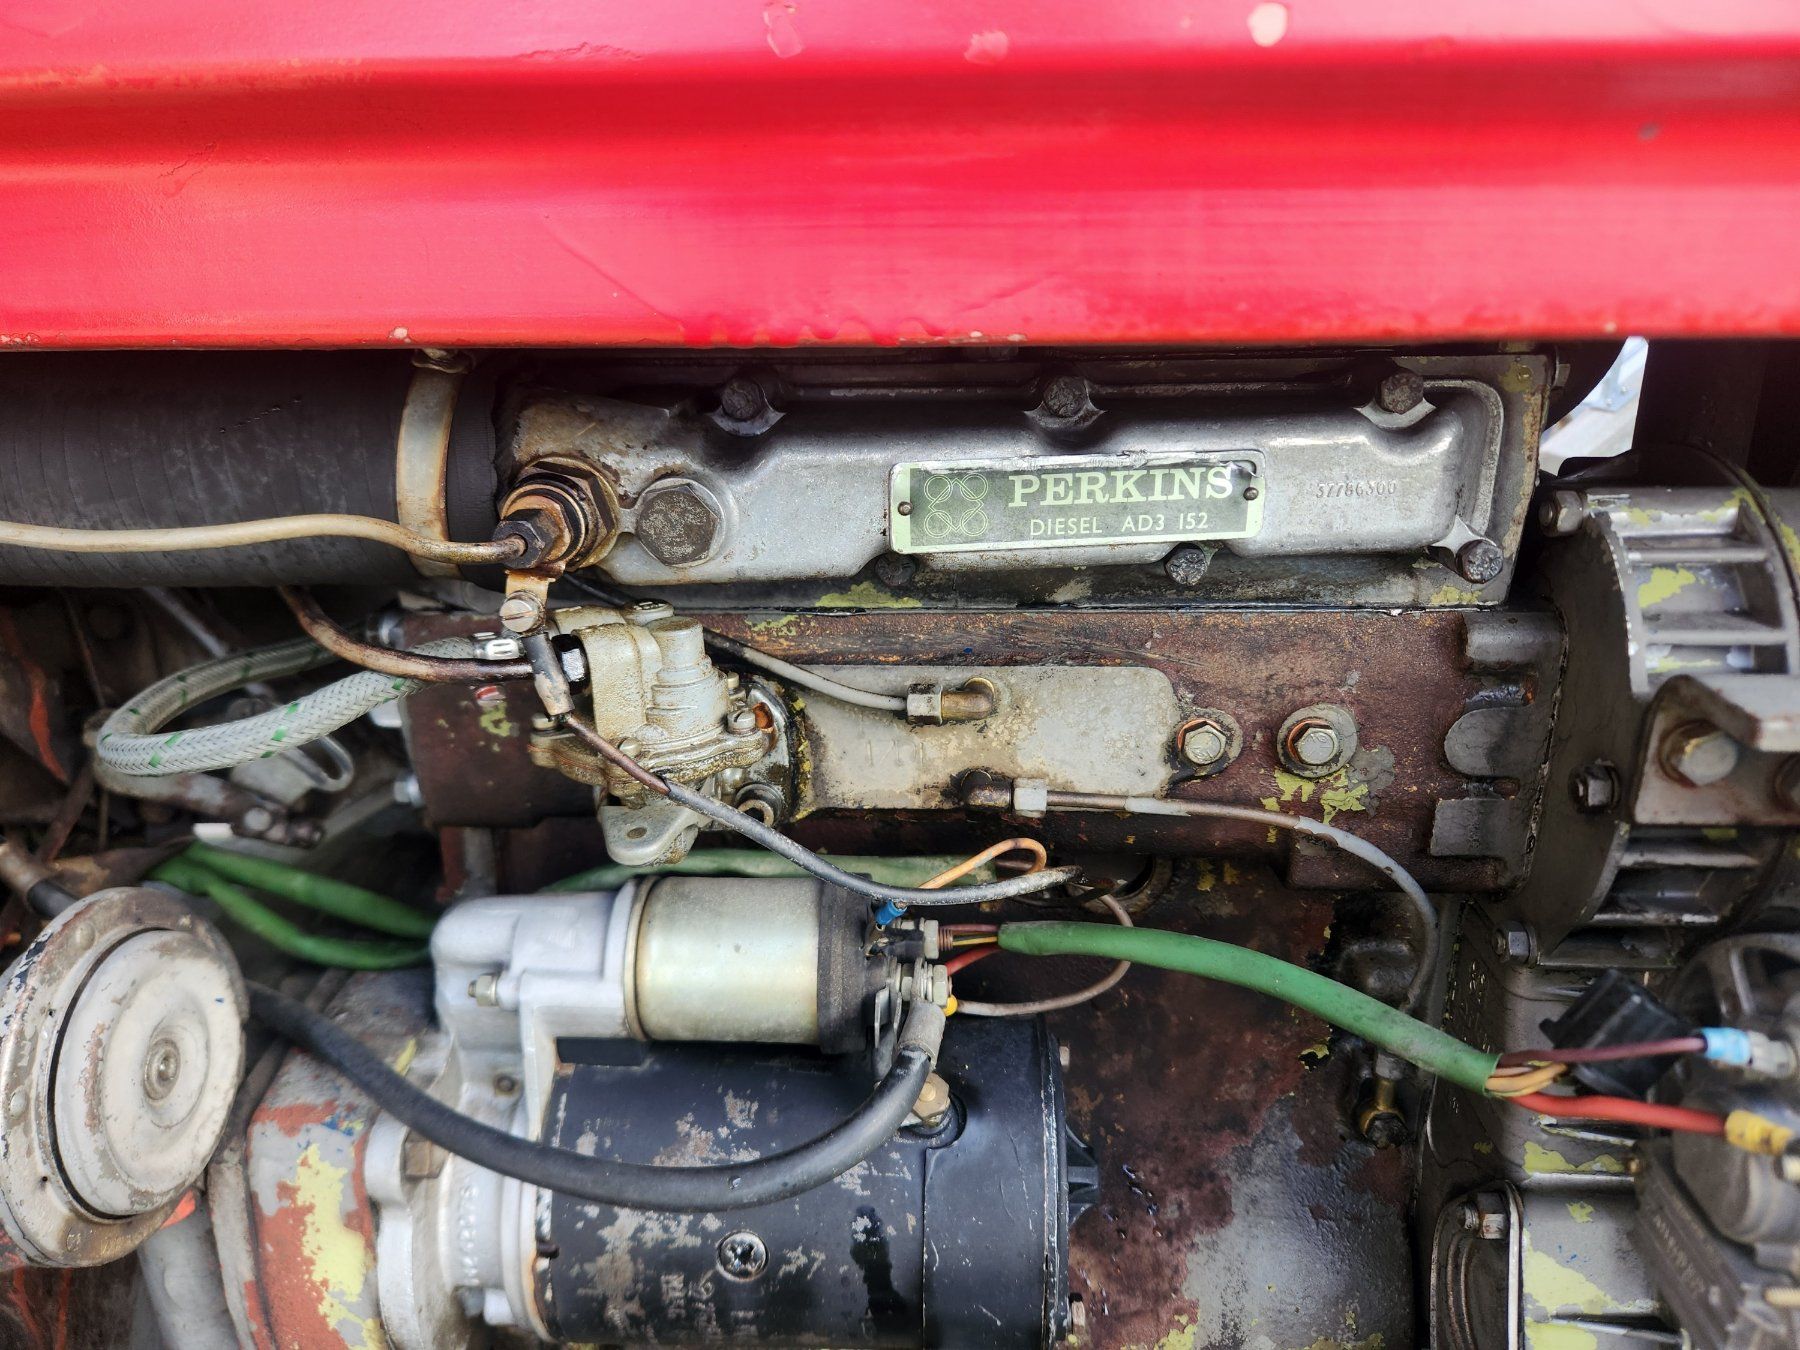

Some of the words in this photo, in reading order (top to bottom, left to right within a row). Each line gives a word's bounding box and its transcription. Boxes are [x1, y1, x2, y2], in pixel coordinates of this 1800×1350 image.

[1008, 466, 1234, 507] PERKINS
[1030, 516, 1103, 536] DIESEL
[1121, 514, 1165, 532] AD3
[1179, 512, 1209, 529] 152
